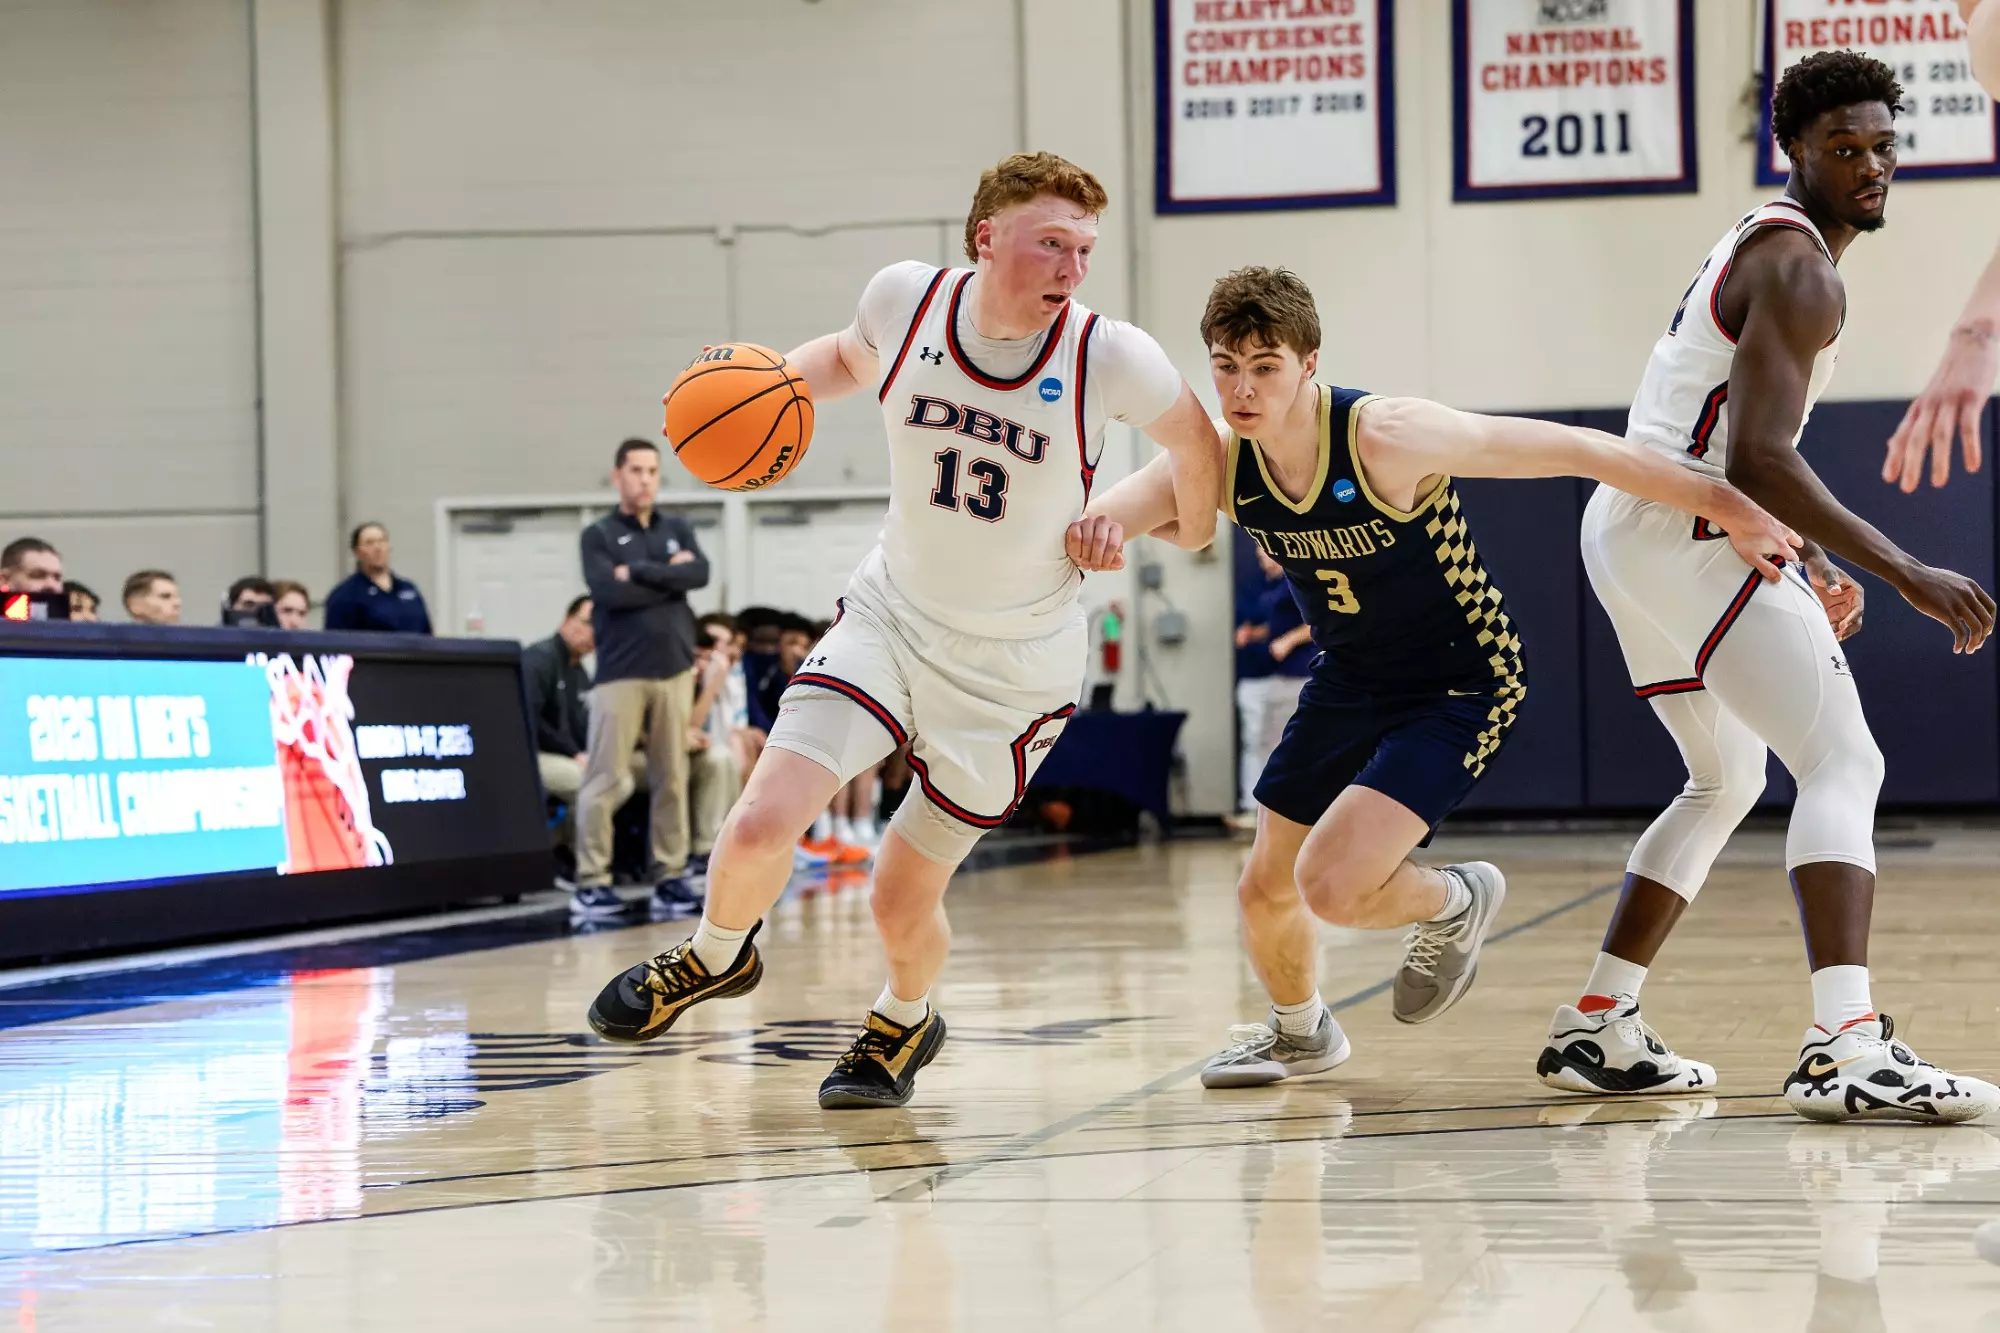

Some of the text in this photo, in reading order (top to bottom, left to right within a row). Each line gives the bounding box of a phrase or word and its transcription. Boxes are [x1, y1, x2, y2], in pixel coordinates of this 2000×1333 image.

[1185, 24, 1363, 53] CONFERENCE
[1506, 27, 1641, 55] NATIONAL
[1785, 13, 1967, 48] REGIONAL
[1184, 54, 1366, 86] CHAMPIONS
[1481, 58, 1667, 93] CHAMPIONS
[1929, 61, 1967, 81] 201
[1521, 111, 1631, 157] 2011
[905, 394, 1050, 464] DBU
[930, 447, 1009, 523] 13
[1274, 518, 1396, 560] EDWARD'S
[1315, 569, 1361, 614] 3
